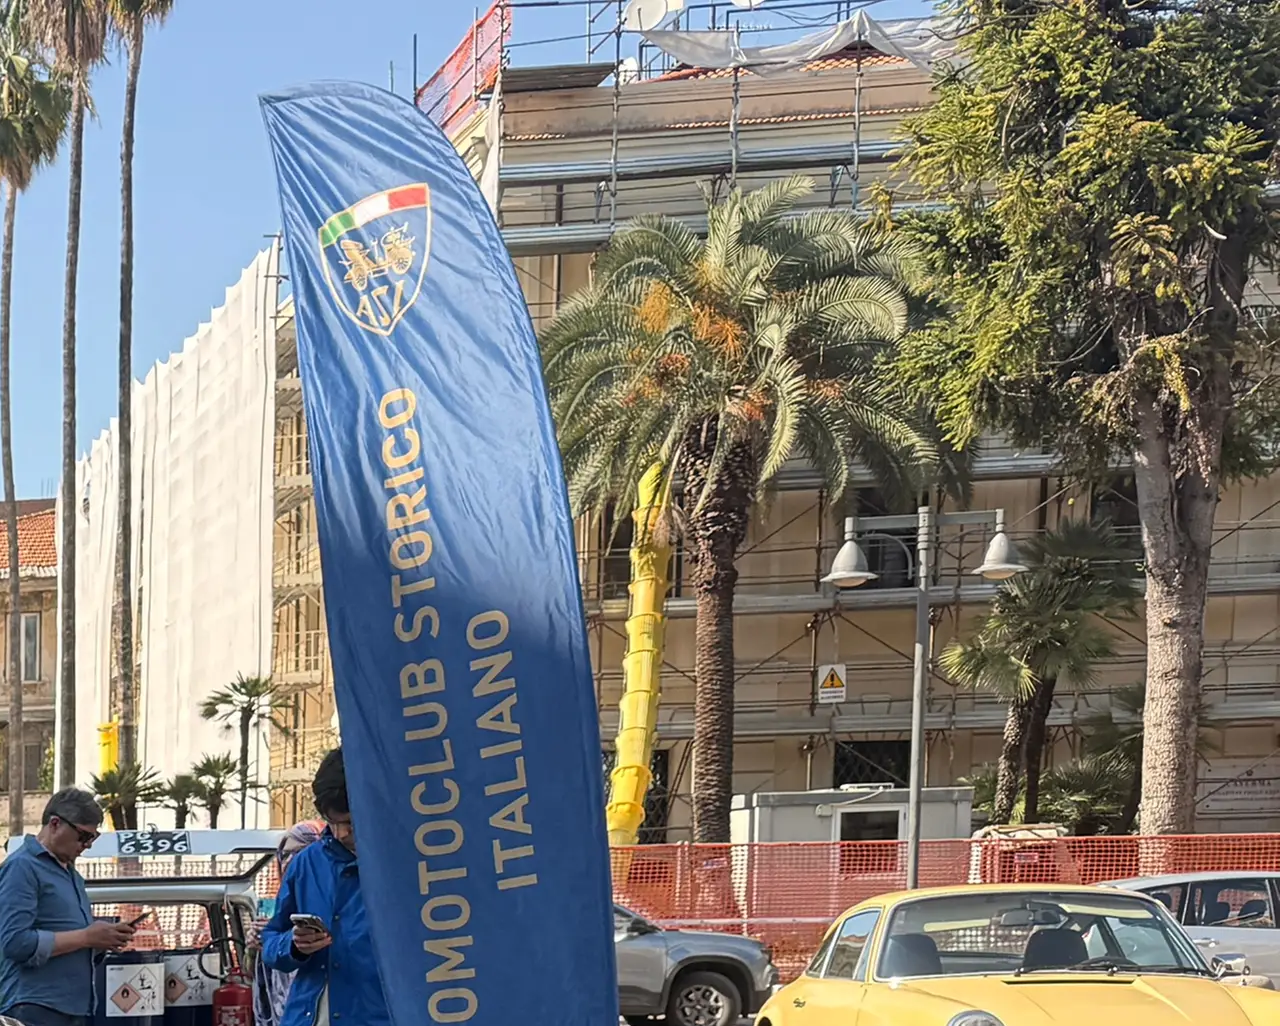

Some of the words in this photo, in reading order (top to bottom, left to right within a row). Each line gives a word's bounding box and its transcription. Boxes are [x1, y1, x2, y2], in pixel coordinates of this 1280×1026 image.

[378, 387, 441, 643] STORICO
[465, 609, 538, 891] ITALIANO
[120, 831, 151, 843] PG
[171, 831, 186, 841] 7
[120, 839, 188, 854] 6396
